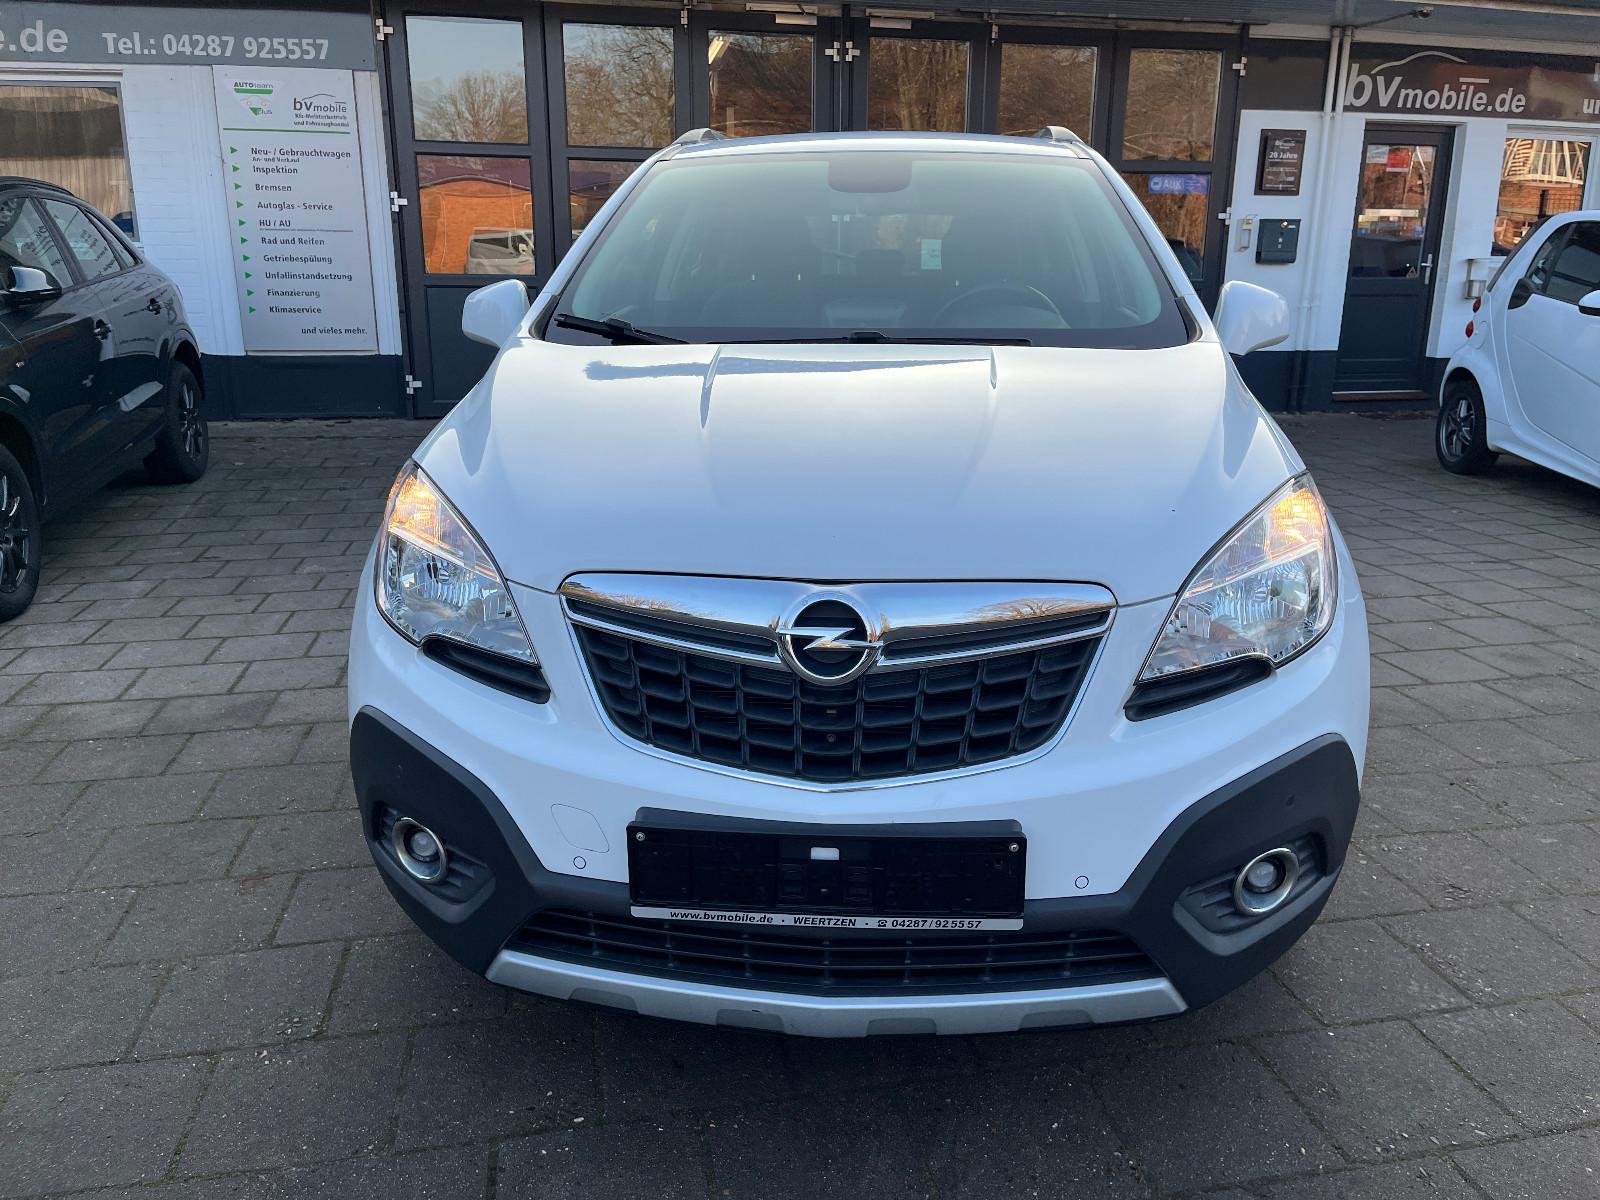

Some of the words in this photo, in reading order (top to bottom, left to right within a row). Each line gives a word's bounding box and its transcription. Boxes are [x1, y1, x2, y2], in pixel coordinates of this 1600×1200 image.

[0, 20, 69, 52] .de
[101, 32, 157, 55] Tel.:
[162, 34, 235, 57] 04287
[243, 37, 329, 60] 925557
[250, 147, 273, 156] Neu-
[278, 148, 351, 160] Gebrauchtwagen
[252, 165, 298, 175] Inspektion
[255, 183, 292, 192] Bremsen
[257, 201, 295, 212] Autoglas
[302, 202, 333, 211] Service
[259, 219, 271, 227] HU
[279, 219, 291, 228] AU
[261, 236, 278, 246] Rad
[279, 236, 296, 246] und
[297, 236, 325, 246] Reifen
[263, 254, 332, 265] Getriebespülung
[265, 271, 353, 282] Unfallinstandsetzung
[267, 288, 321, 299] Finanzierung
[269, 305, 322, 314] Klimaservice
[301, 325, 317, 335] und
[318, 325, 343, 335] vieles
[344, 325, 368, 336] mehr.
[670, 911, 774, 924] www.bvmobile.de
[793, 916, 857, 927] WEERTZEN
